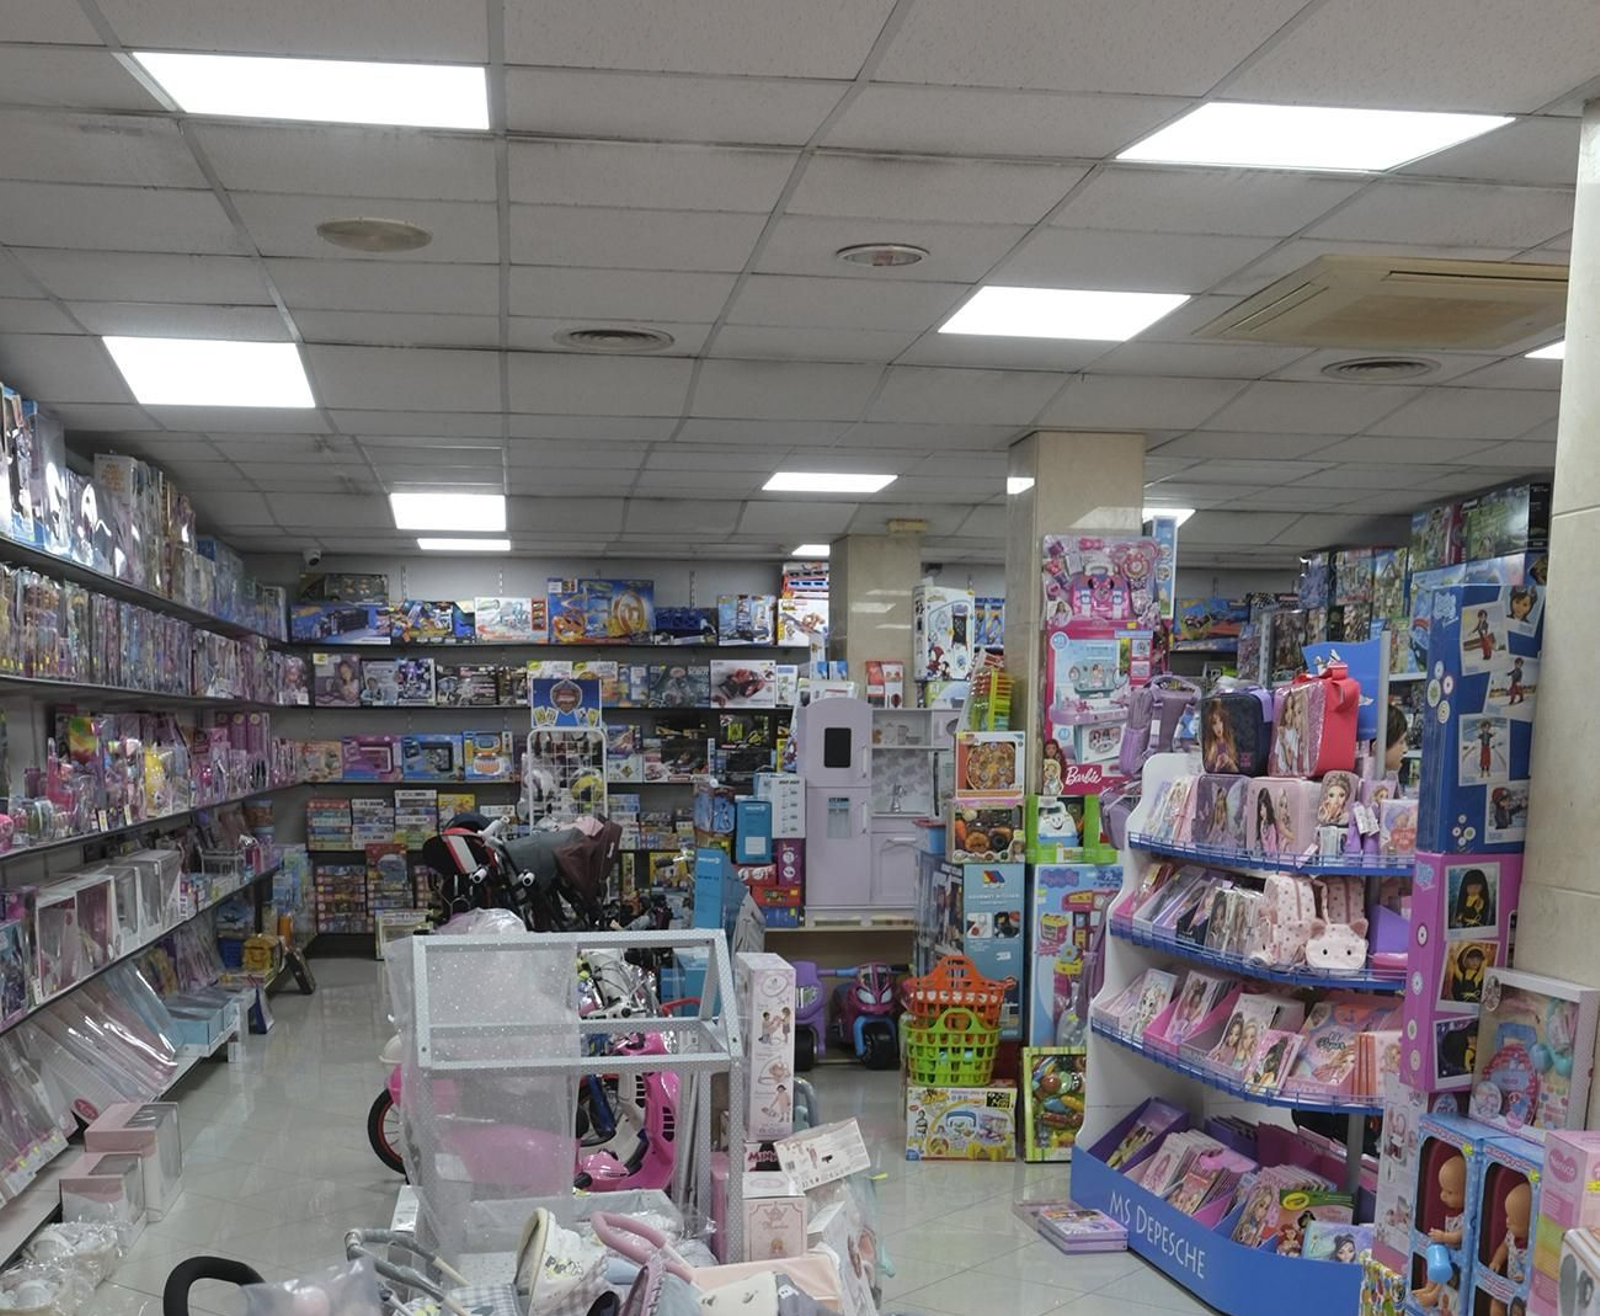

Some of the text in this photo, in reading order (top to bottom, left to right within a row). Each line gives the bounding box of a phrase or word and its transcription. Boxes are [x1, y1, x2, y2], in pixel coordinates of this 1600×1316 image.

[1065, 766, 1102, 786] Barbie
[1109, 1191, 1207, 1280] MS DEPESCHE
